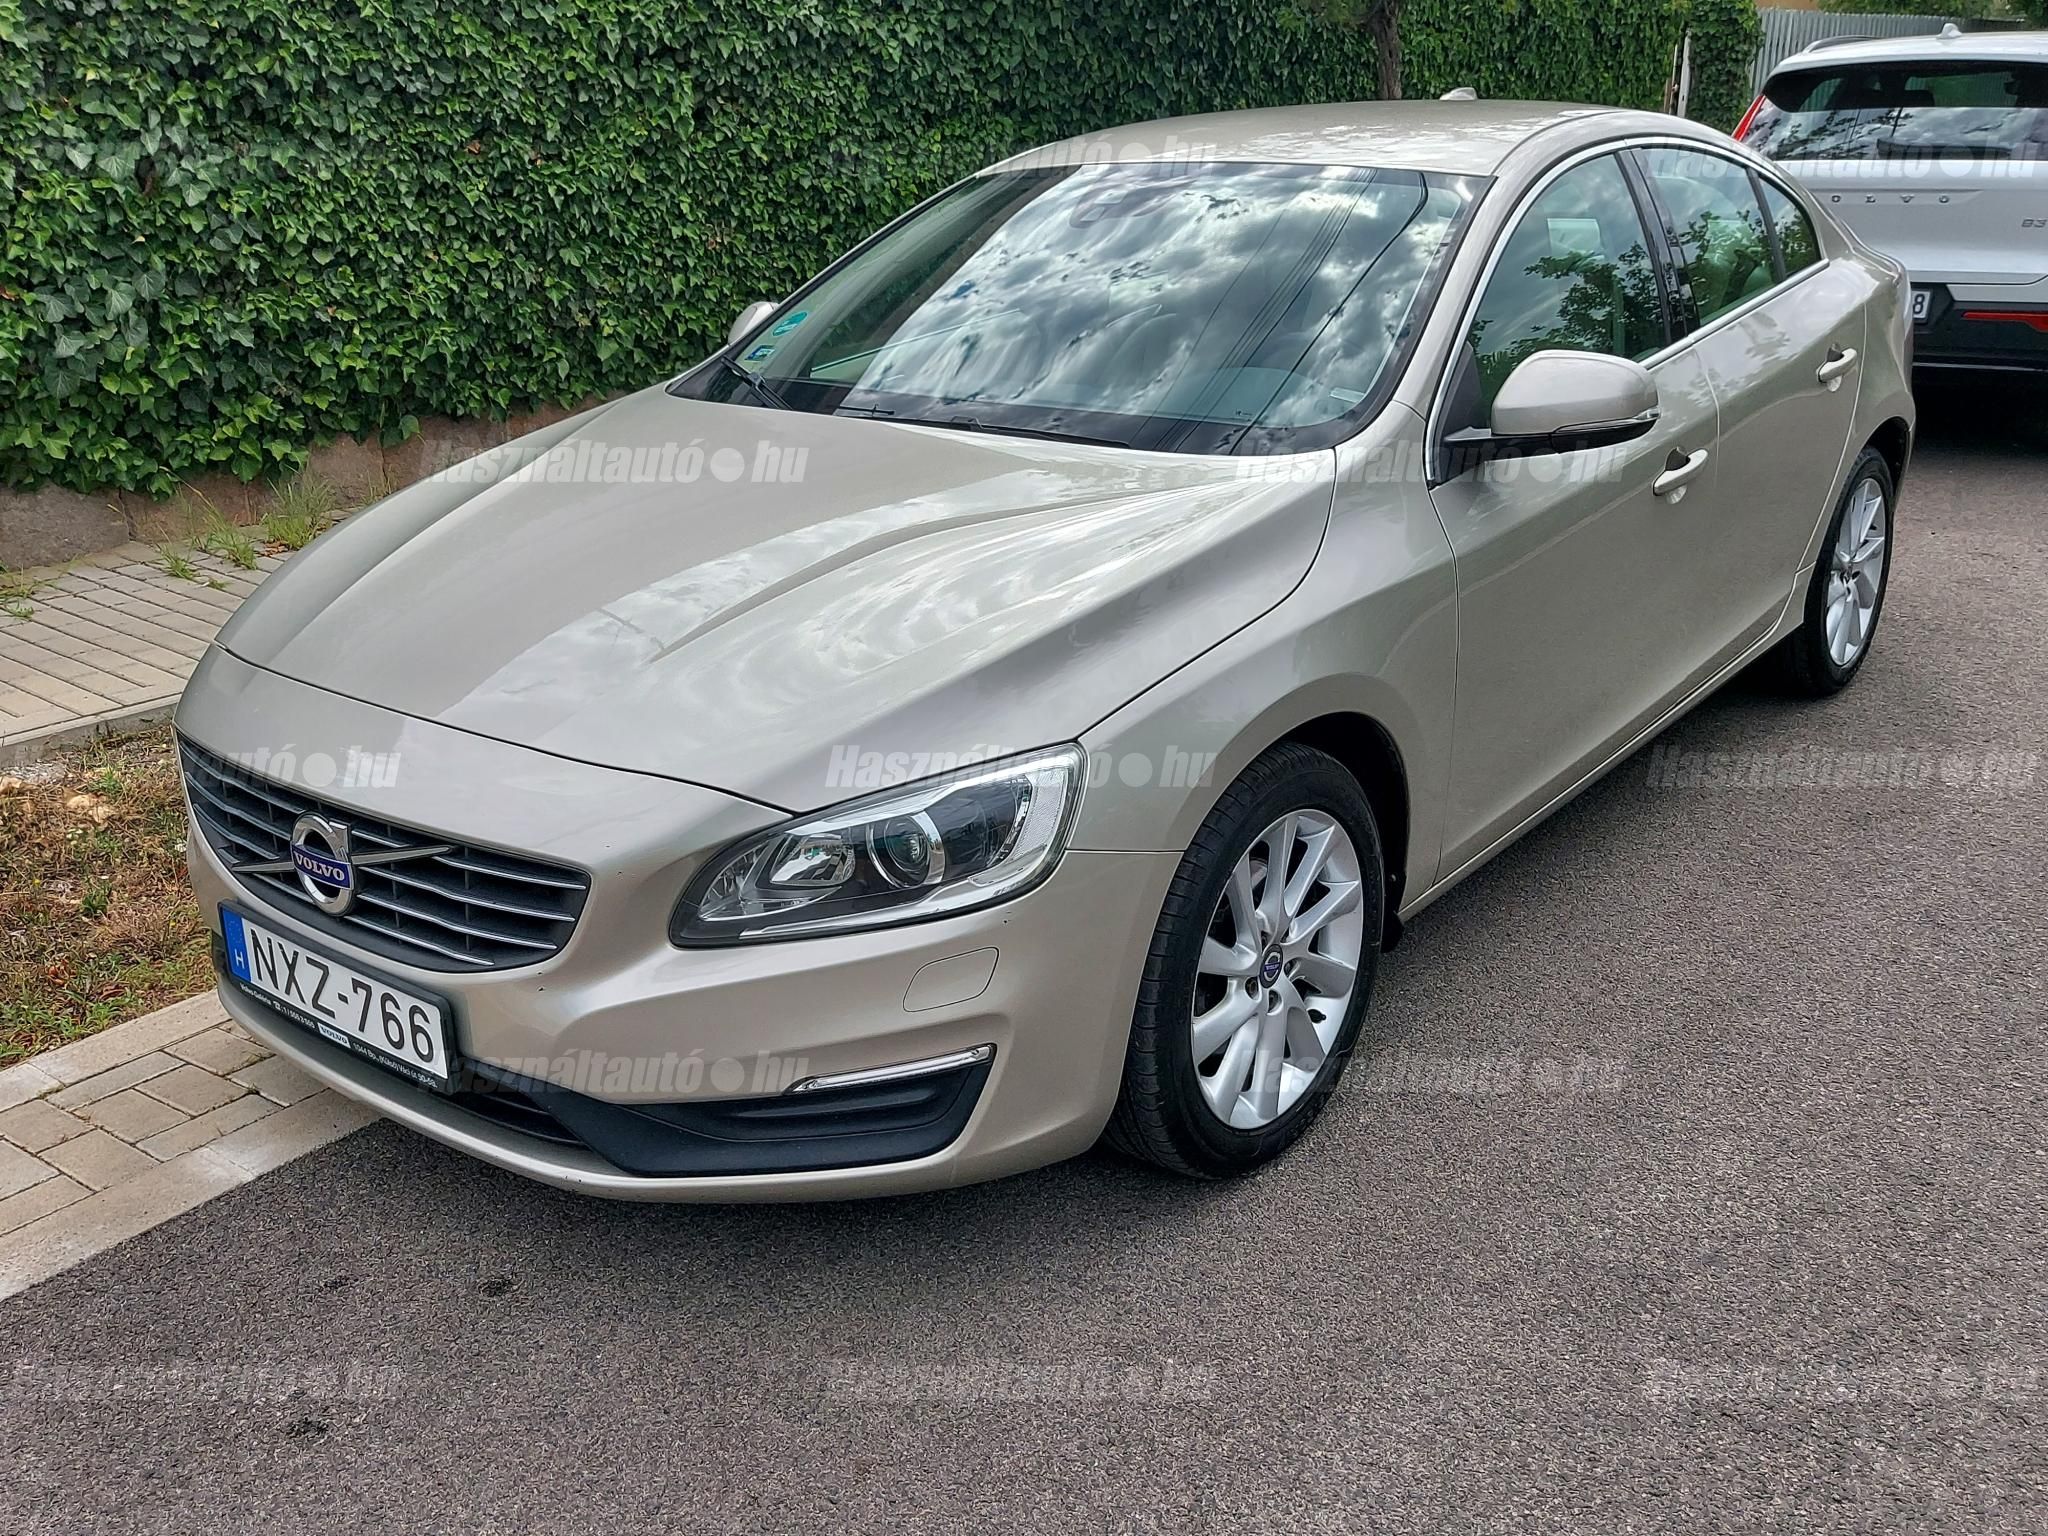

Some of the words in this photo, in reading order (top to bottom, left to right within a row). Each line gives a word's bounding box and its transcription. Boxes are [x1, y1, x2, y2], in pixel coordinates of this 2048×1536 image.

[294, 850, 345, 881] VOLVO
[234, 948, 246, 970] H
[250, 928, 435, 1064] NXZ-766
[320, 1025, 348, 1045] VOLVO
